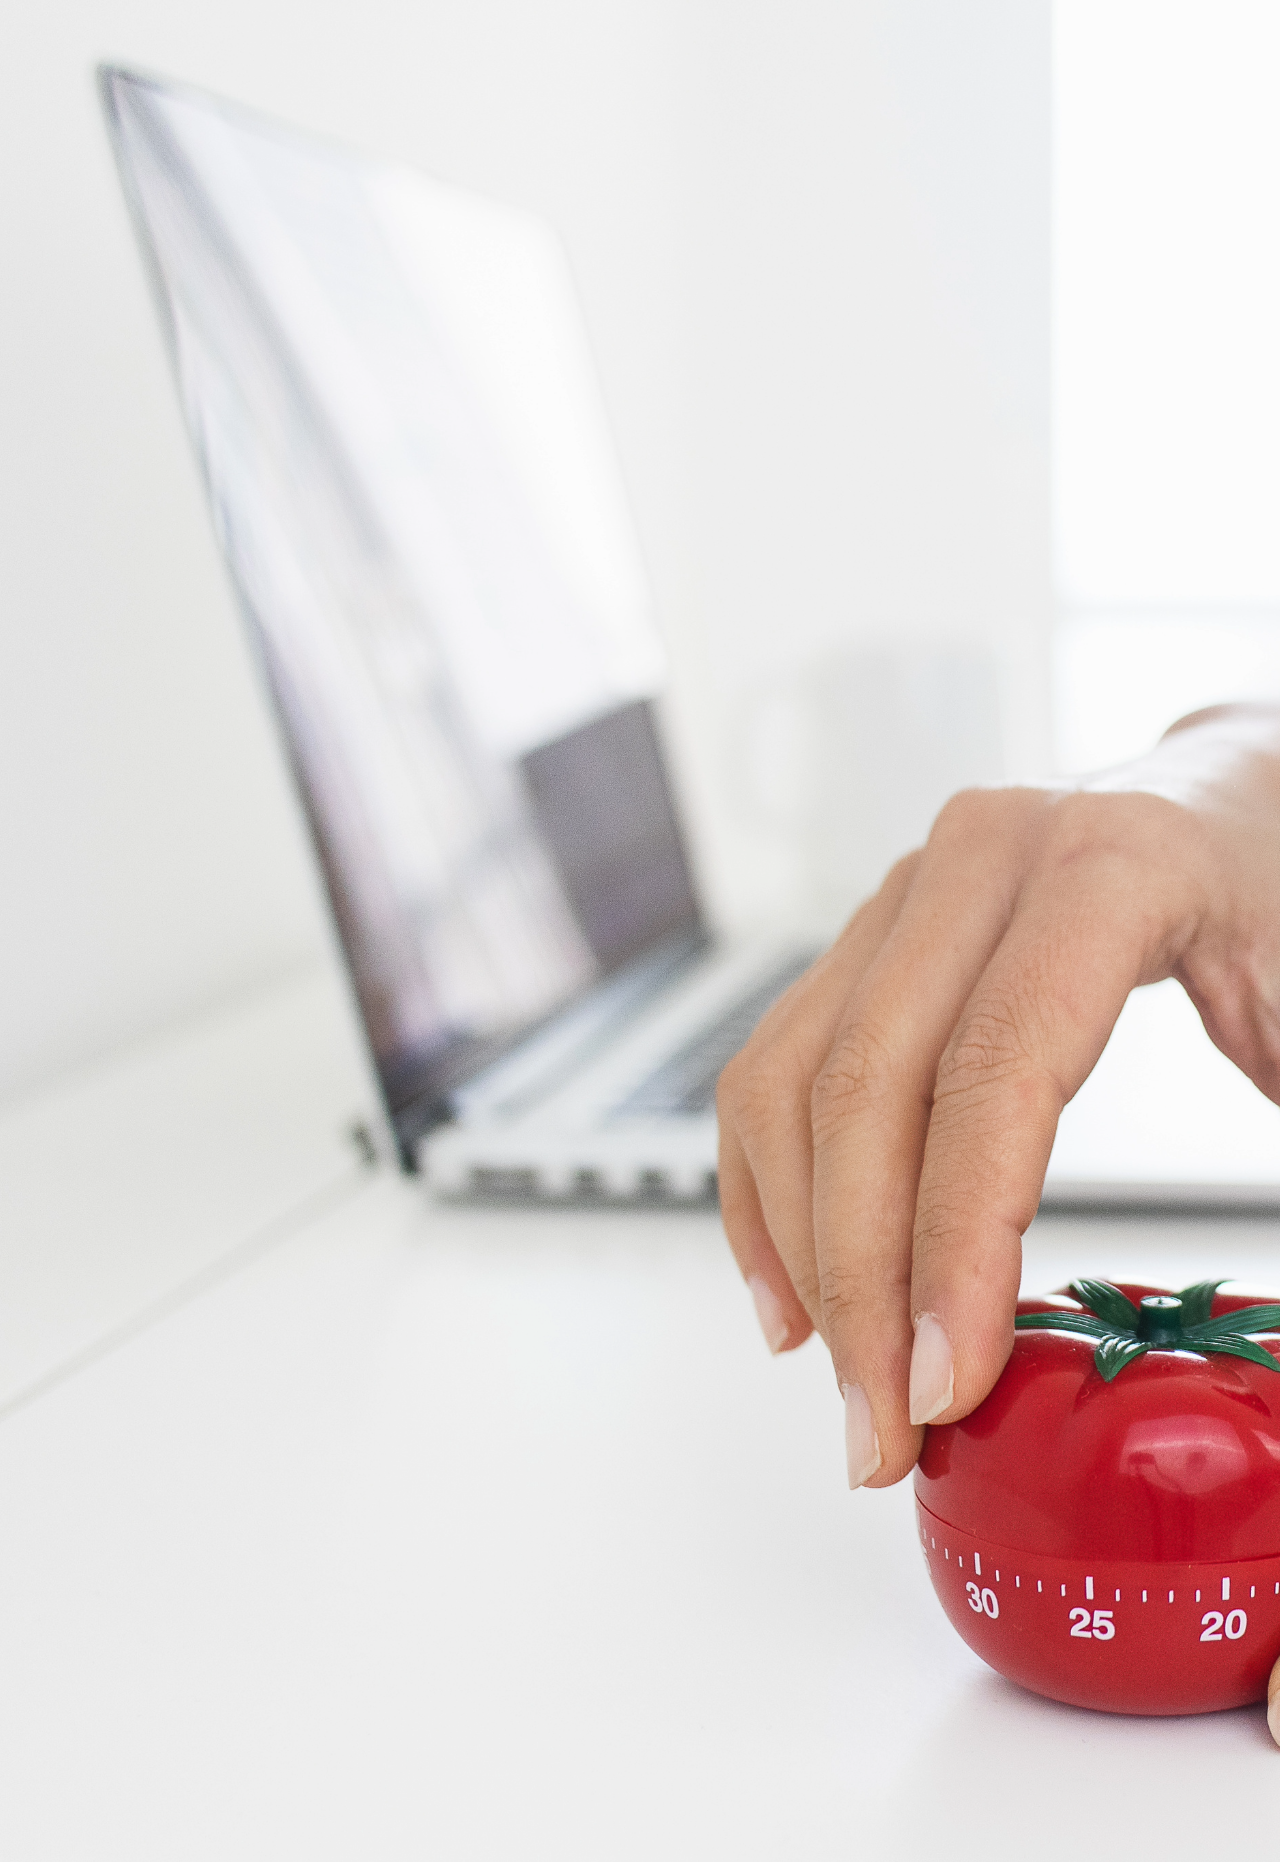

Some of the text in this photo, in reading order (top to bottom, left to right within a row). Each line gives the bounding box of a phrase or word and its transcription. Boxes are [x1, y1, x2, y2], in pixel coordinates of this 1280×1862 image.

[965, 1581, 1248, 1642] 30 25 20
